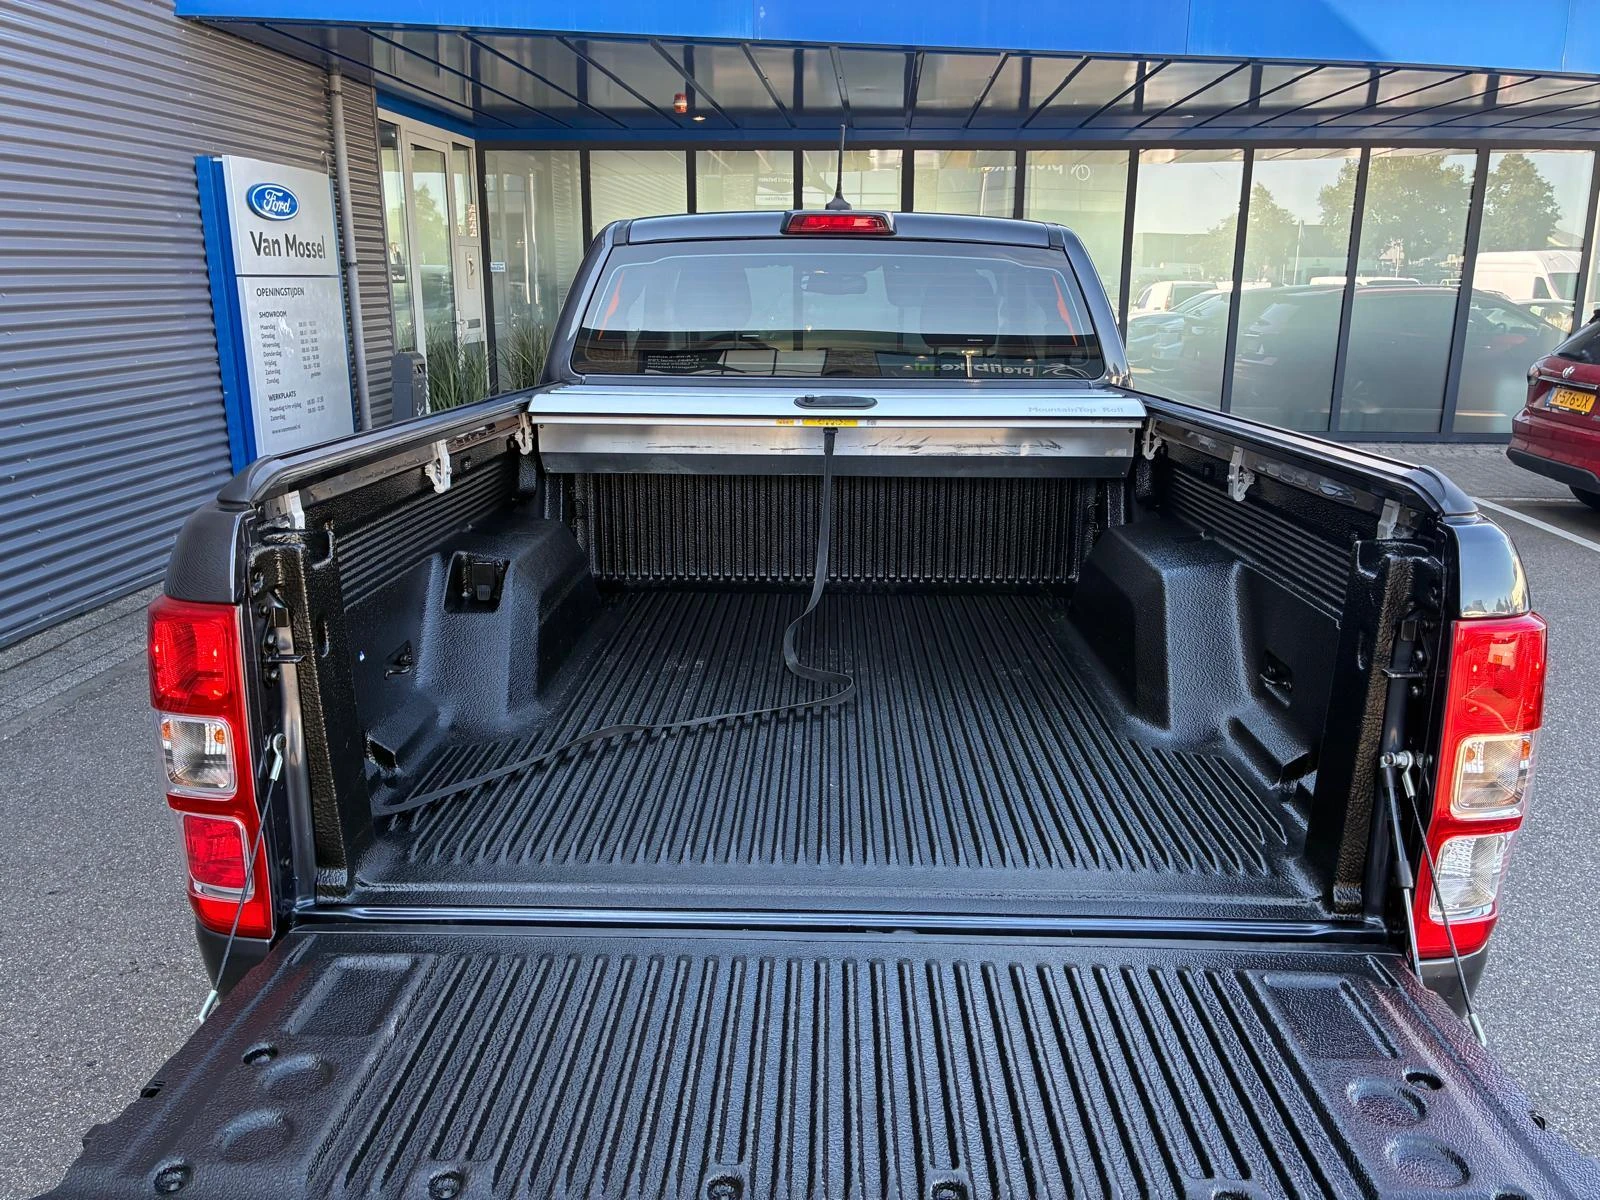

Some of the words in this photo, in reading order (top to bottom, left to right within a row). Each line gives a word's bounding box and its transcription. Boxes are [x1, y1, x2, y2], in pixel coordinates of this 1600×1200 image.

[264, 189, 291, 213] Ford
[249, 231, 282, 257] Van
[284, 233, 326, 259] Mossel
[256, 287, 305, 298] OPENINGSTIJDEN
[259, 310, 287, 318] SHOWROOM
[268, 391, 297, 401] WERKPLAATS
